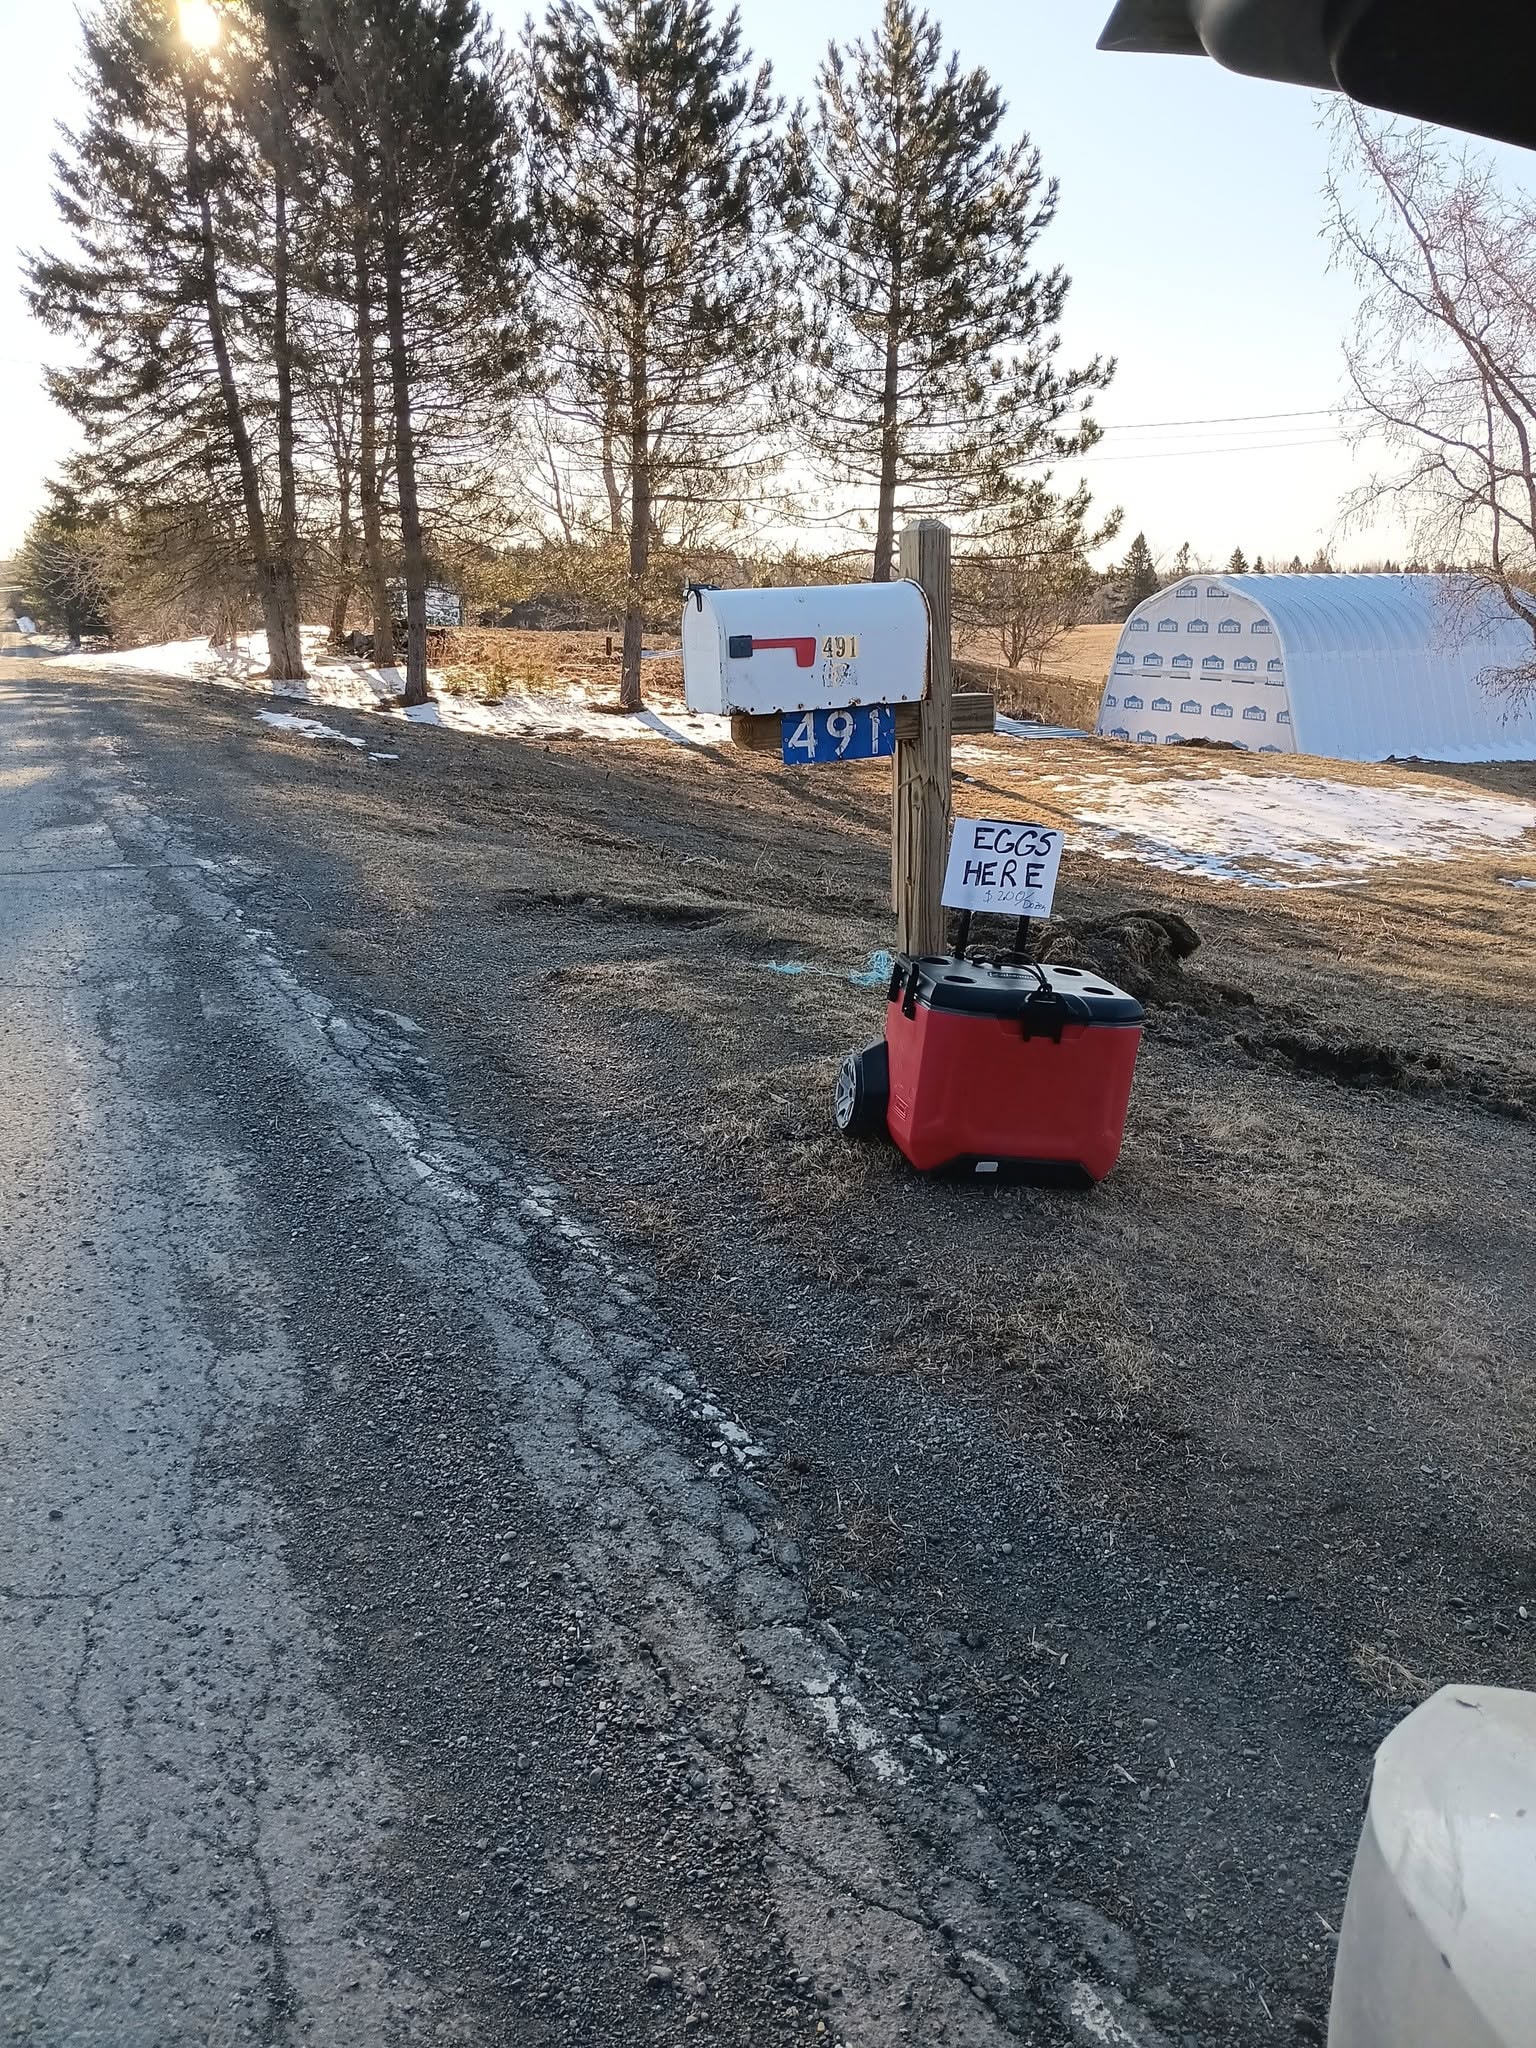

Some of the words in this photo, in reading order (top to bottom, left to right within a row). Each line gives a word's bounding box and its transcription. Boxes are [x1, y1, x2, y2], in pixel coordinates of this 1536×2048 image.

[823, 637, 856, 657] 491
[788, 709, 880, 758] 491
[974, 827, 1057, 856] EGGS
[963, 859, 1045, 888] HERE
